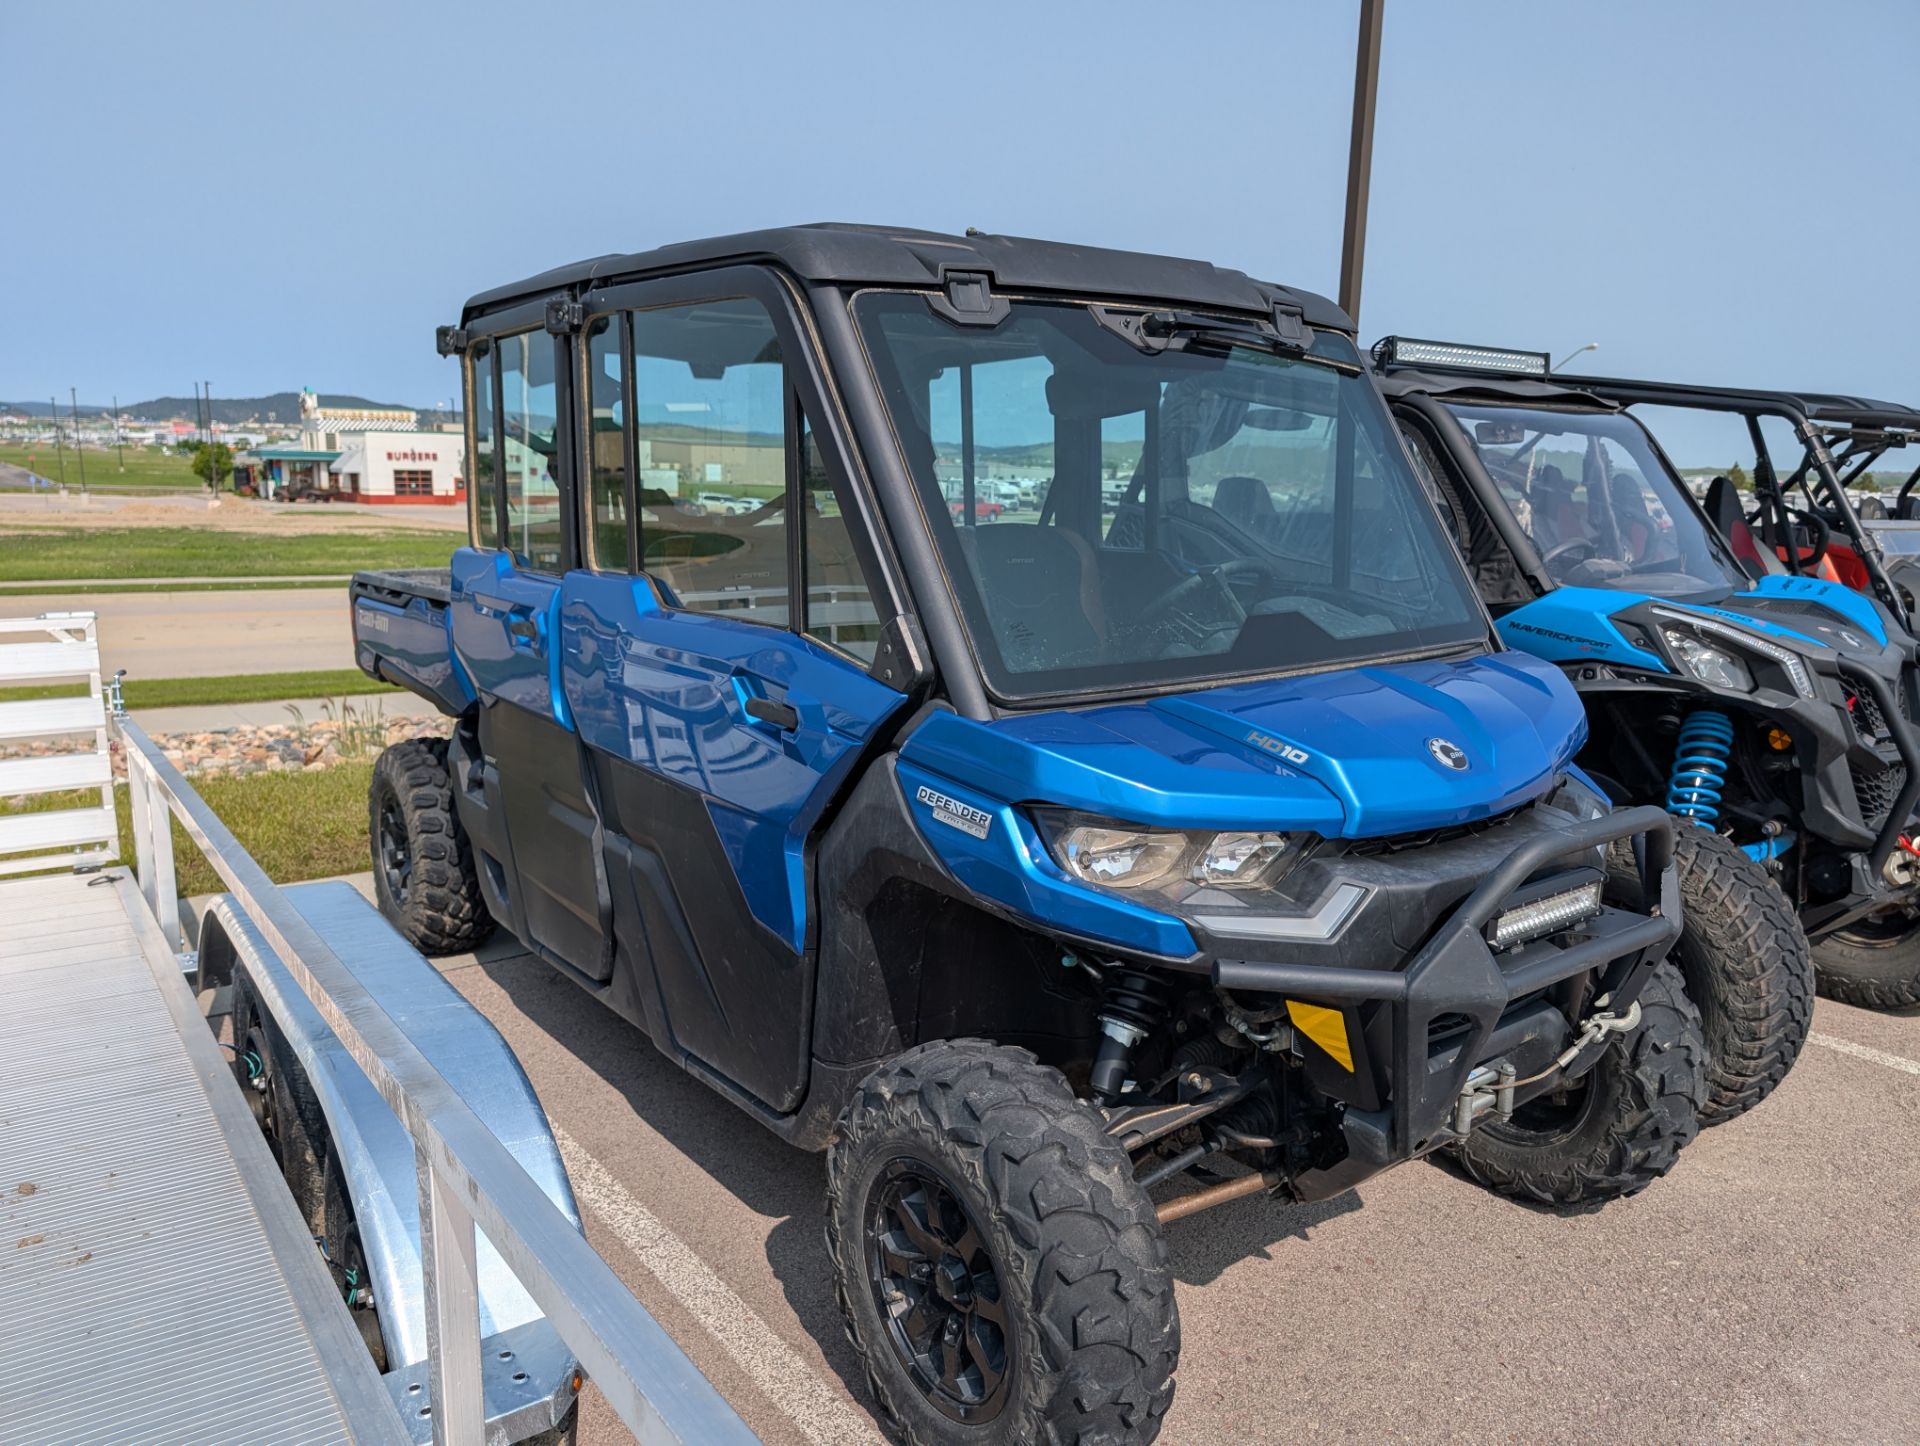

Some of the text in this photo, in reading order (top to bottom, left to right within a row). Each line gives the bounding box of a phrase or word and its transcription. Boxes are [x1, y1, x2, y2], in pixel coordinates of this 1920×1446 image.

[387, 451, 438, 462] BURGERS
[1508, 620, 1613, 649] MAVERICK SPORT
[1245, 730, 1309, 764] HD10
[1449, 751, 1464, 759] BRP
[919, 788, 989, 826] DEFENDER
